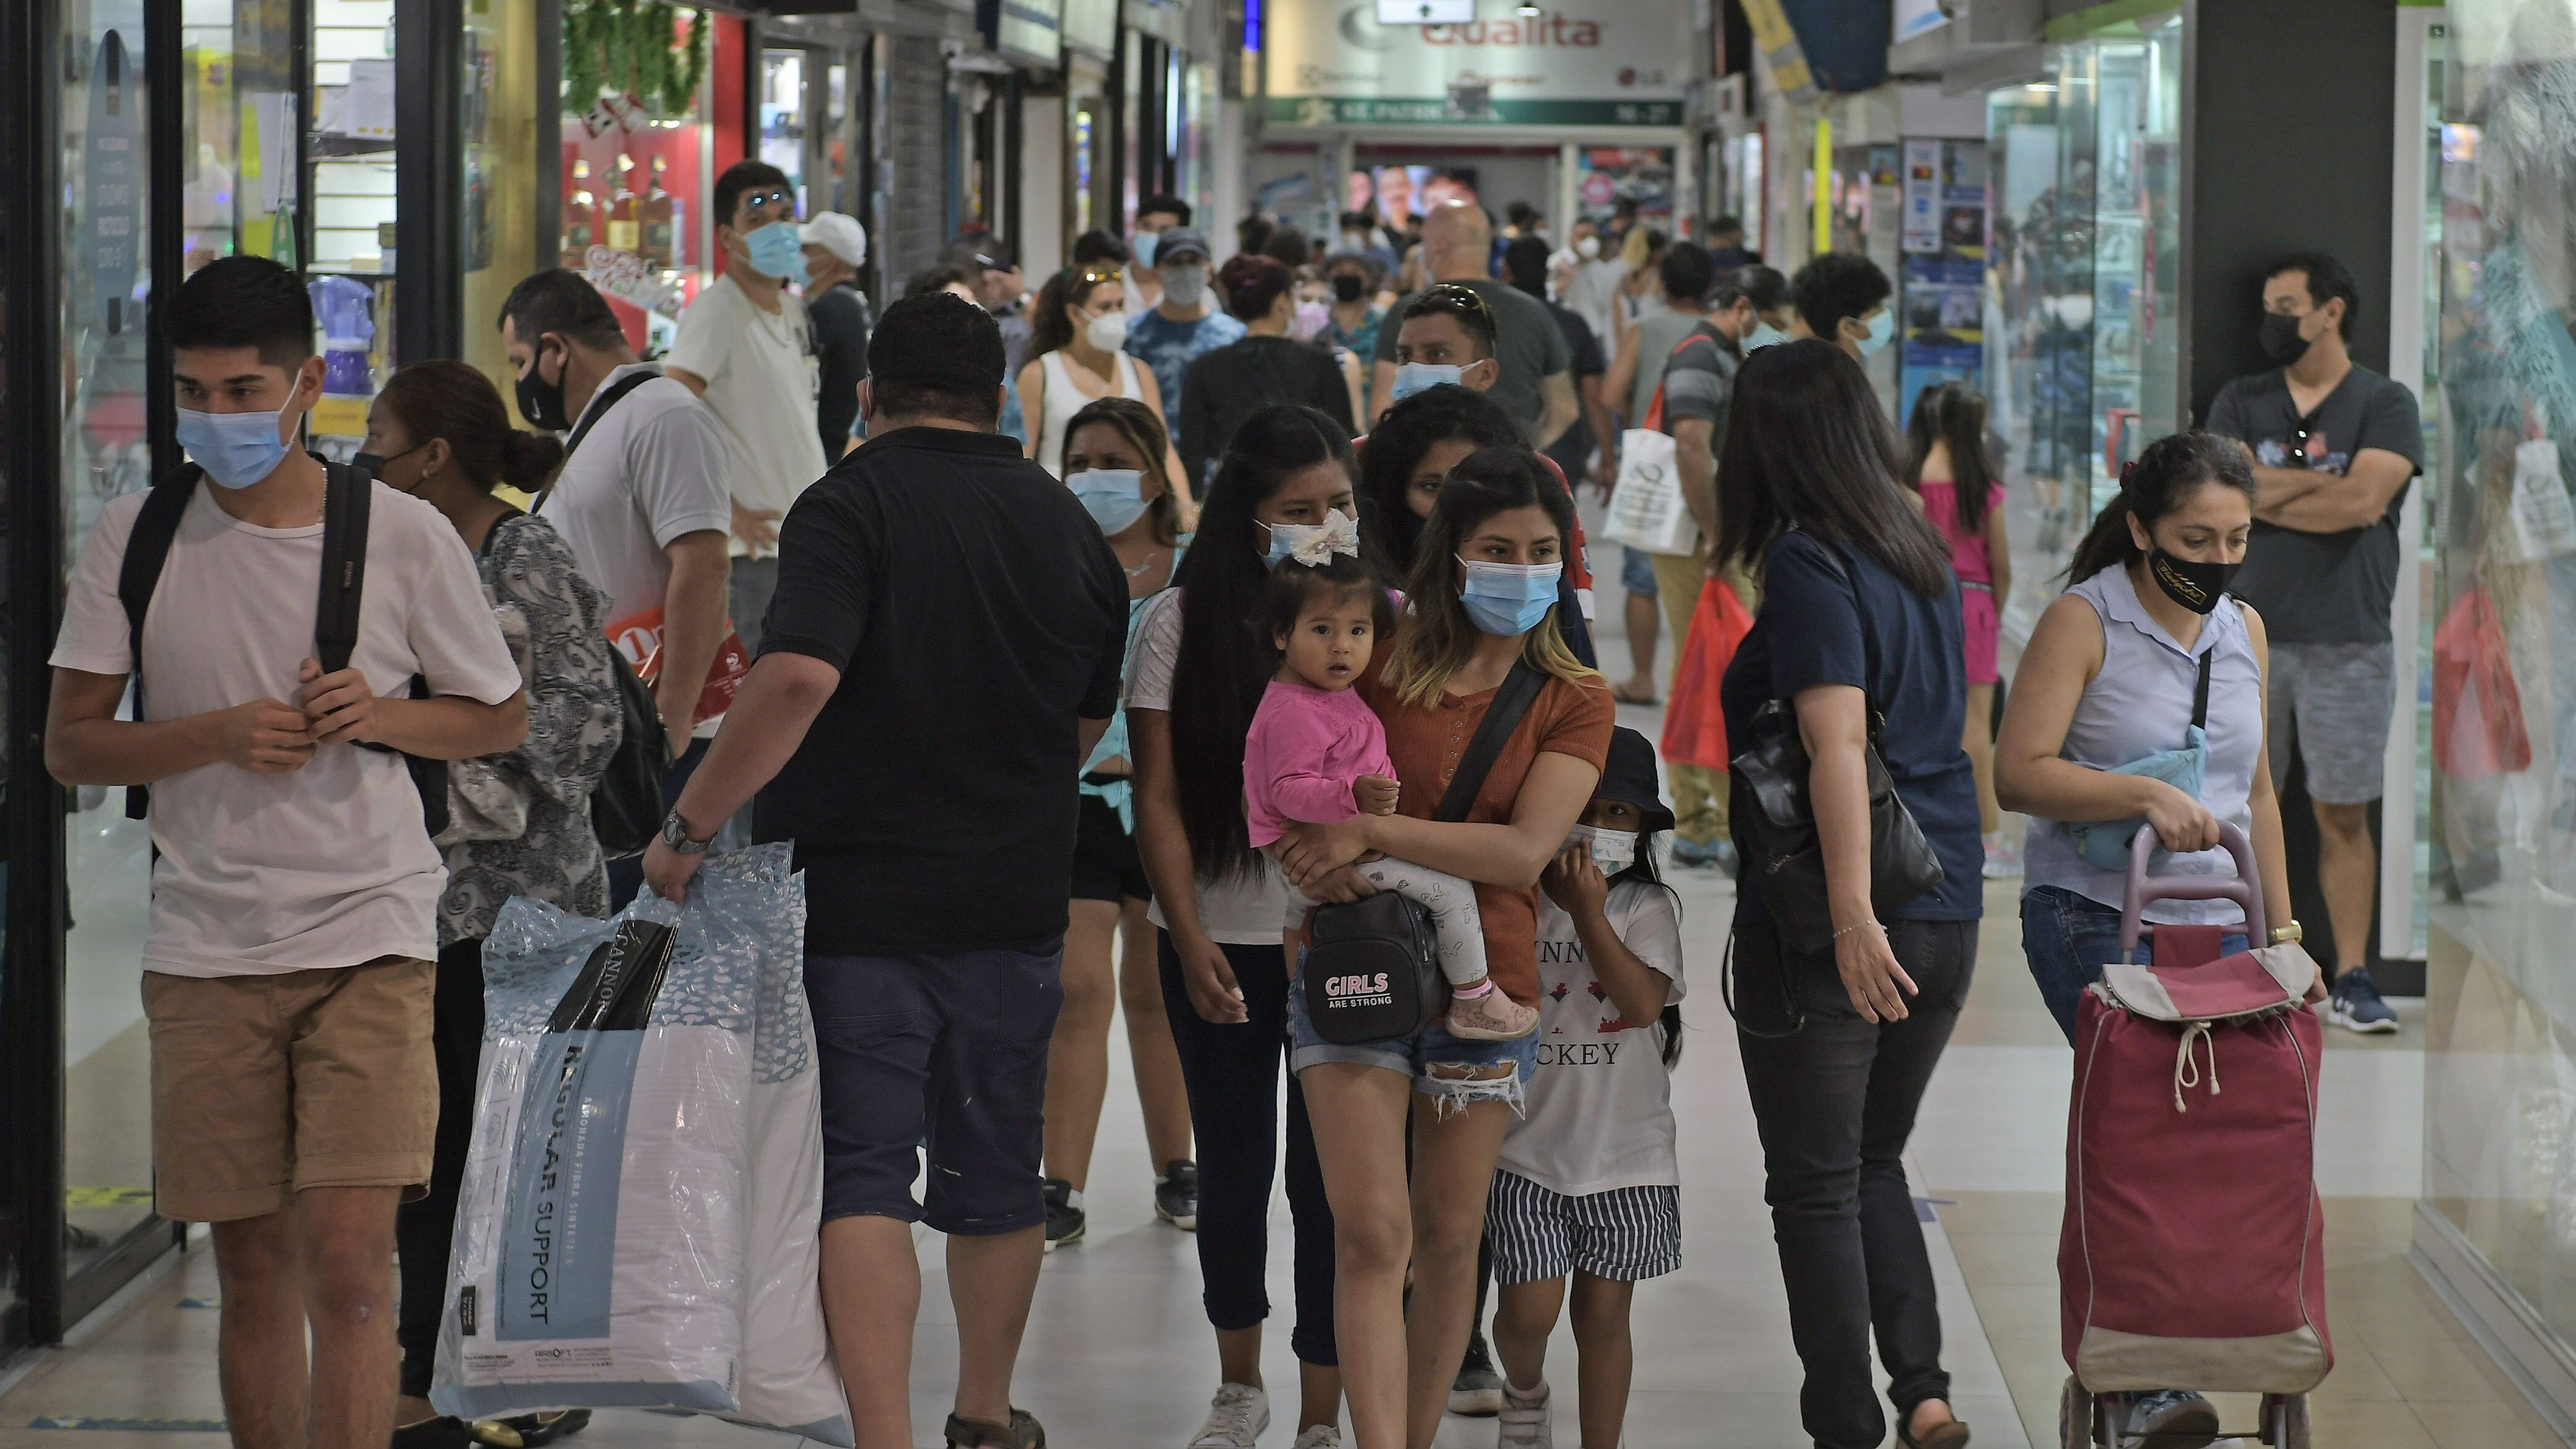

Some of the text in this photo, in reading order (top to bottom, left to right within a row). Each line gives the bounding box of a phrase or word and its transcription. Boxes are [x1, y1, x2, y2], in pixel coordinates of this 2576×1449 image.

[1325, 972, 1389, 996] GIRLS
[1329, 996, 1392, 1009] ARE STRONG
[575, 1096, 593, 1158] ALMOHADA
[530, 1046, 583, 1326] REGULAR SUPPORT
[570, 1162, 584, 1196] FIBRA
